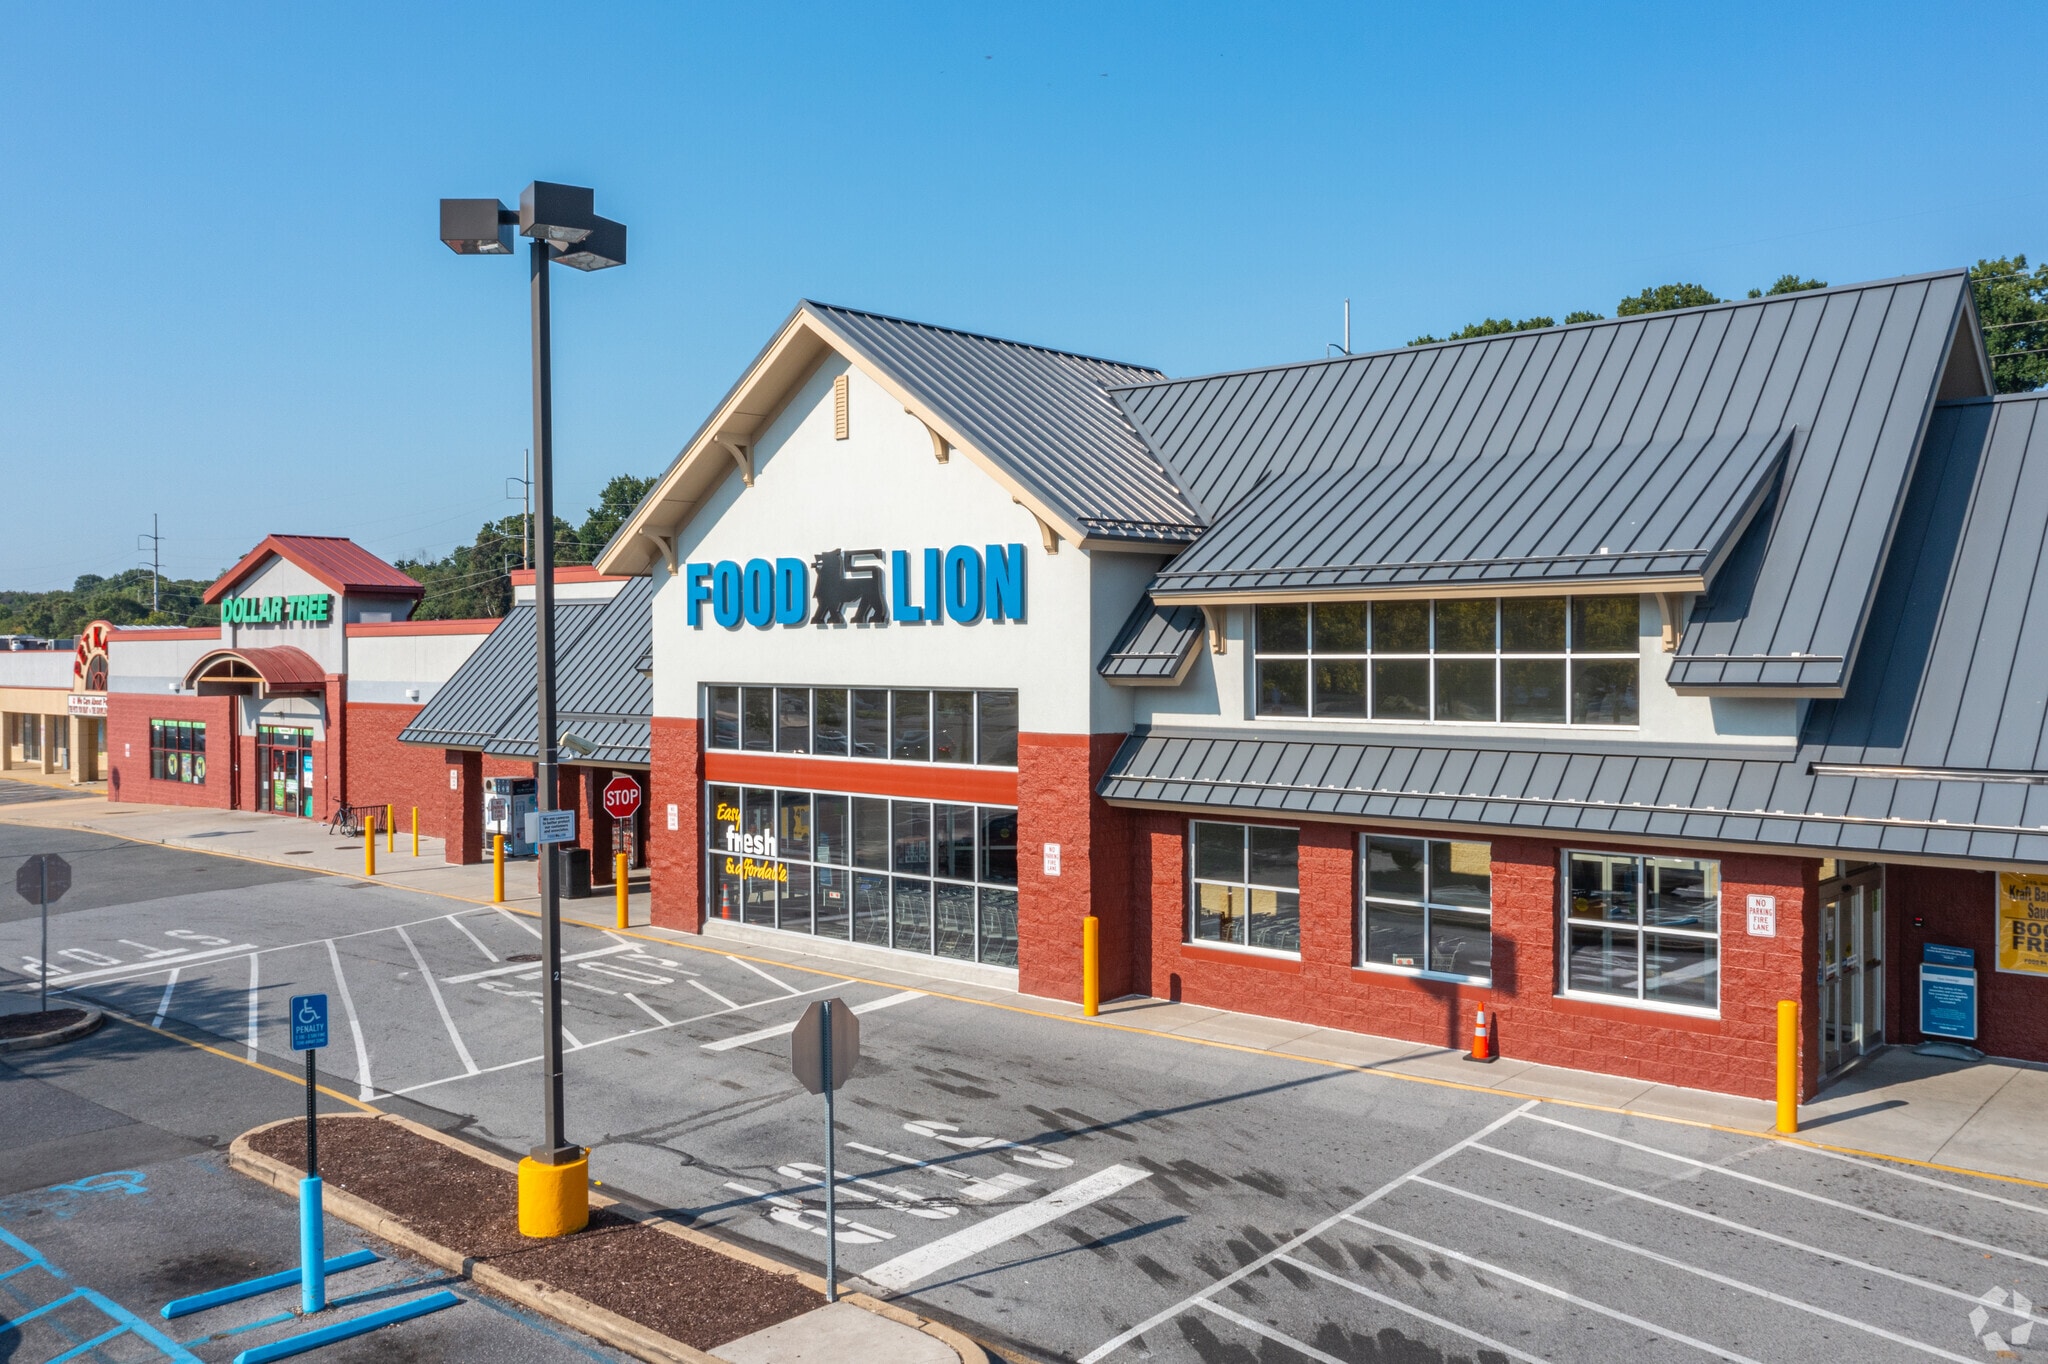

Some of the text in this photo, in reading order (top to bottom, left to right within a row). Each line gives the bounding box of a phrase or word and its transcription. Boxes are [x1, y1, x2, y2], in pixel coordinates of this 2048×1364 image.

[687, 543, 1024, 627] FOOD LION
[222, 594, 329, 623] DOLLAR TREE
[606, 788, 639, 806] STOP
[716, 803, 741, 831] Easy
[726, 824, 776, 856] fresh
[725, 857, 735, 874] &
[2009, 884, 2032, 901] Kraft
[1750, 907, 1773, 916] PARKING
[1755, 899, 1767, 907] NO
[1753, 916, 1769, 924] FIRE
[554, 971, 560, 980] 2
[296, 1023, 325, 1034] PENALTY
